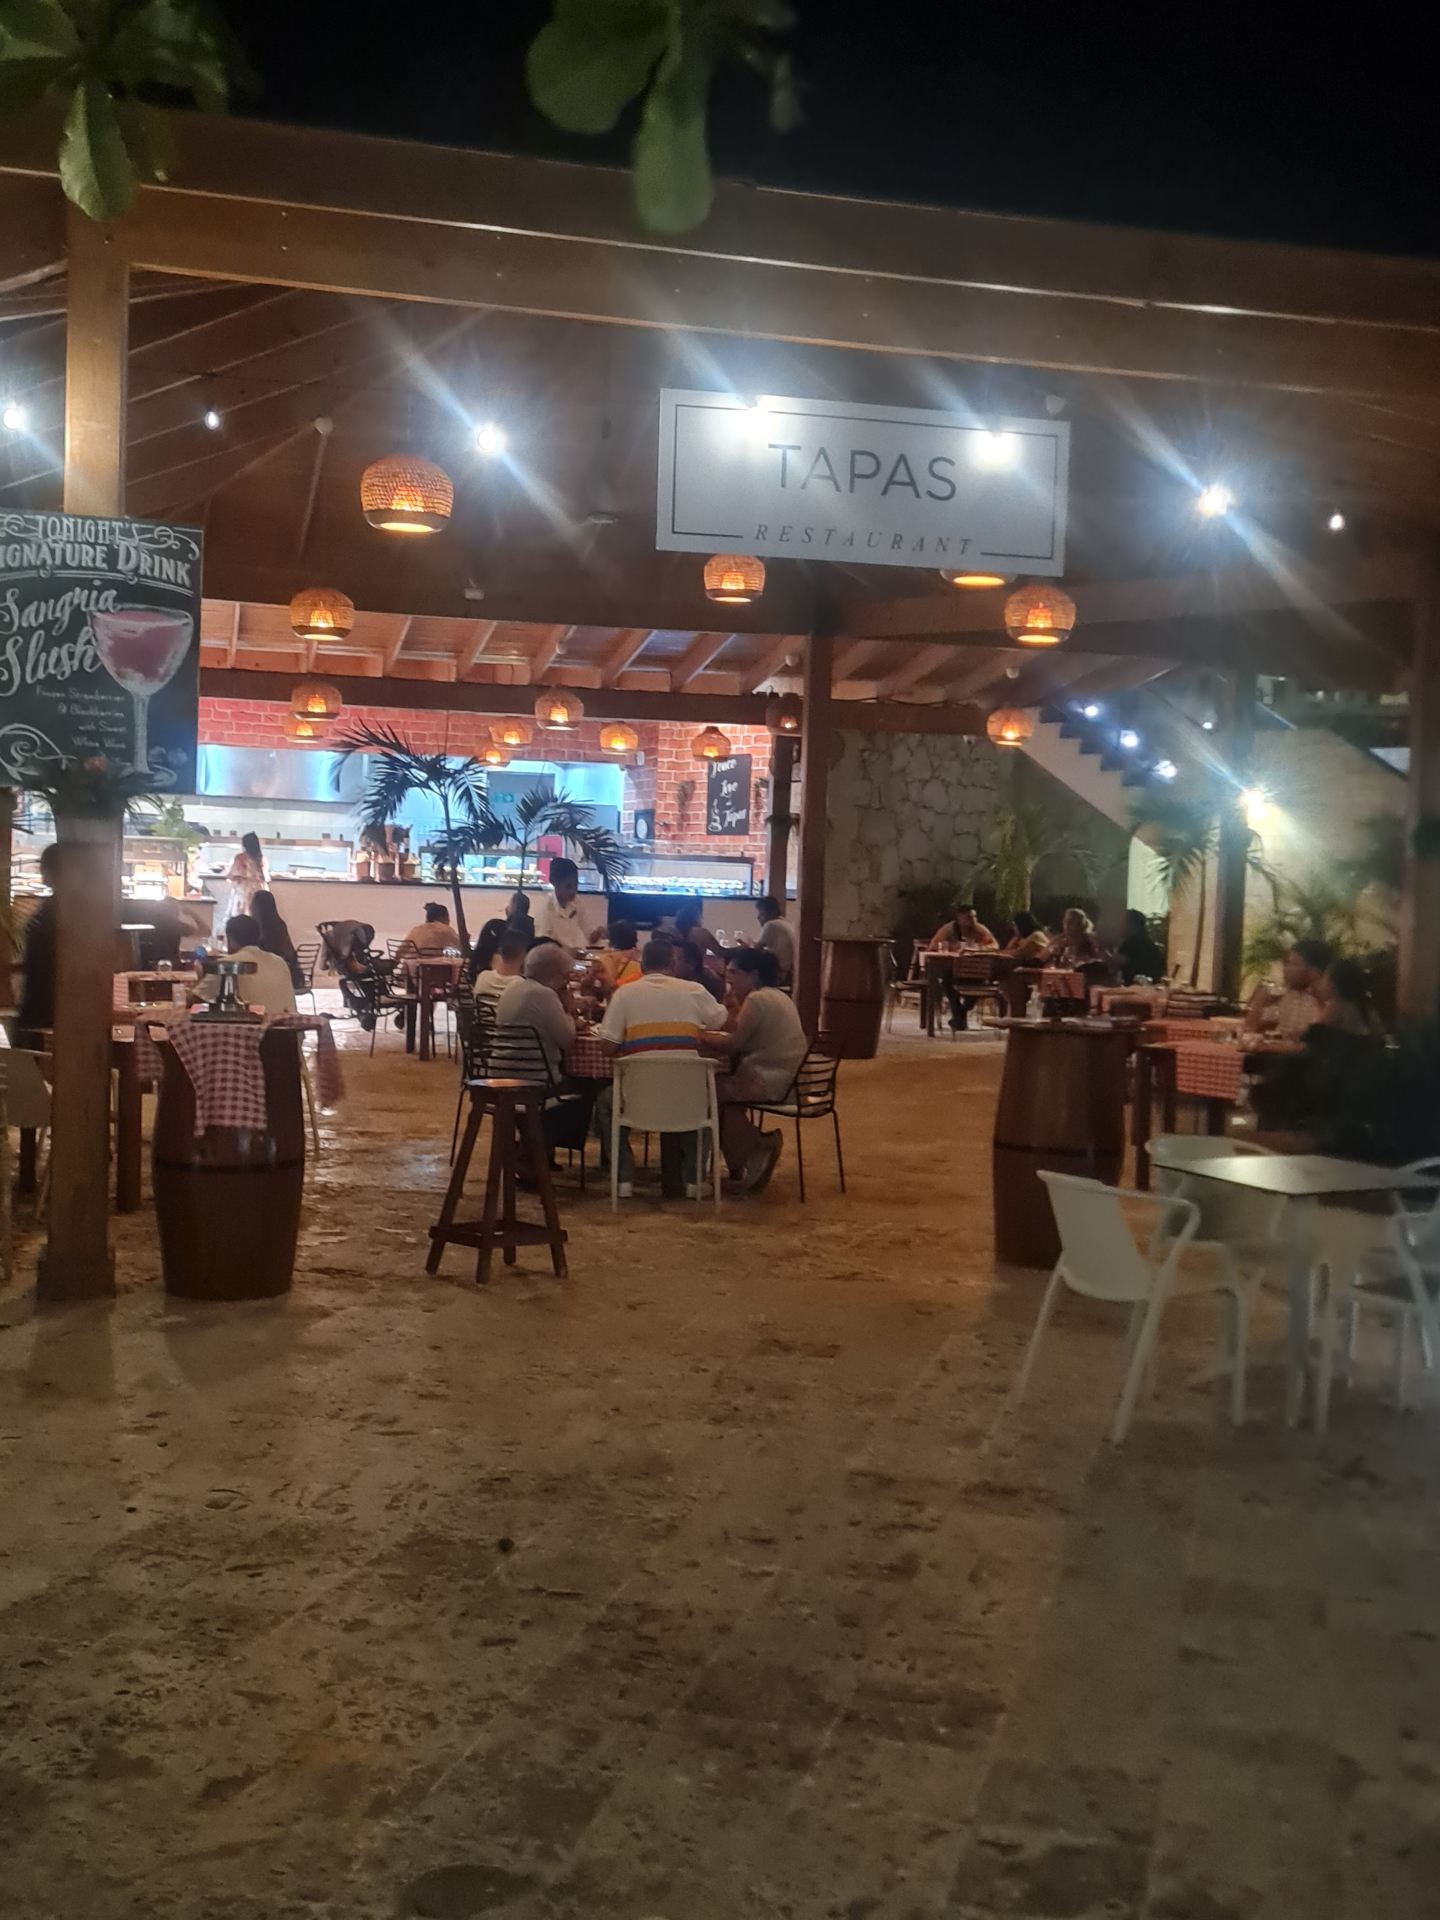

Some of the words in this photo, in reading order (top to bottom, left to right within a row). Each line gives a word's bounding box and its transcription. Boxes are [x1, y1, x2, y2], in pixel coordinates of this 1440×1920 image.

[768, 442, 957, 502] TAPAS
[754, 523, 975, 557] RESTAURANT
[0, 579, 119, 636] Sangria
[0, 627, 103, 698] Slush
